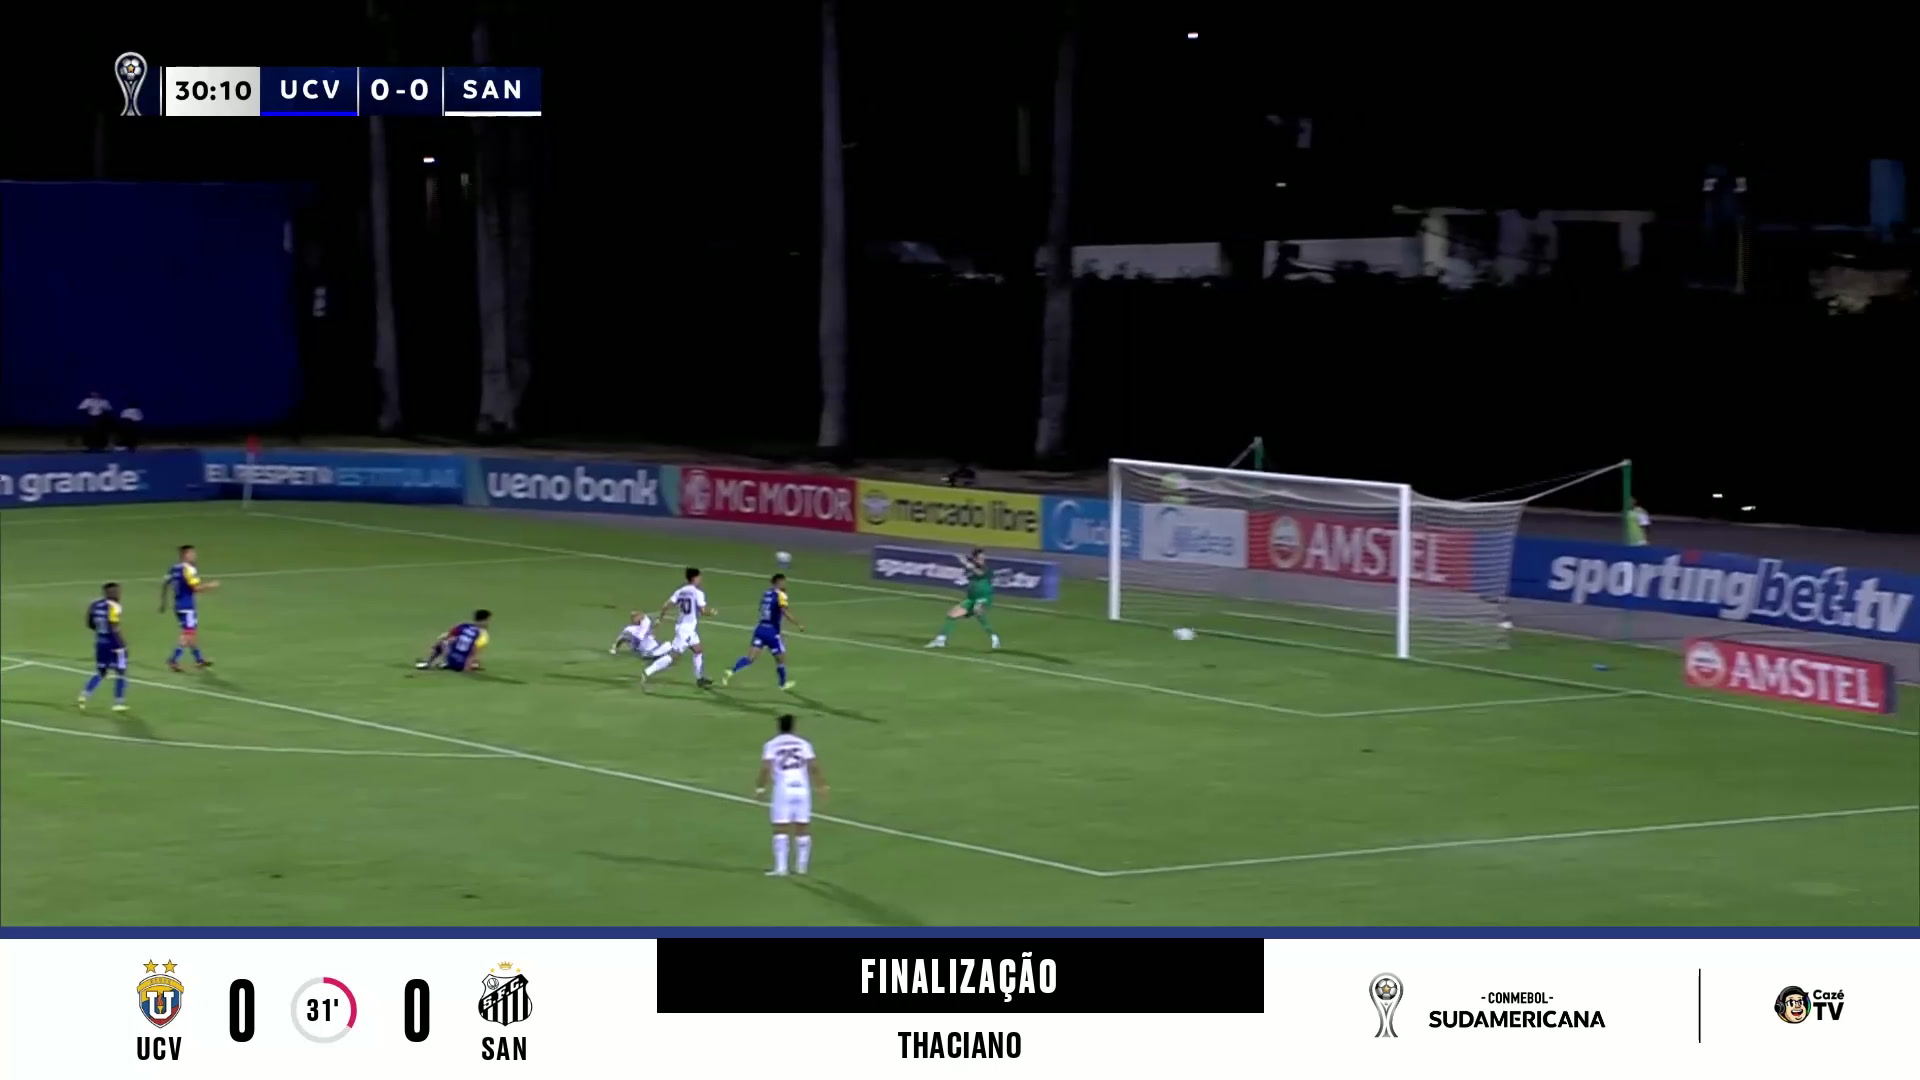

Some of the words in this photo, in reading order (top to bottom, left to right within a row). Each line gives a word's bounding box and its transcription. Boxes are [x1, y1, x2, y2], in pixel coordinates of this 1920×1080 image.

[19, 463, 140, 502] grande
[487, 469, 572, 501] ueno
[574, 466, 658, 507] bank
[713, 477, 757, 513] MG
[758, 481, 854, 522] MOTOR
[894, 497, 985, 529] mercado
[987, 500, 1037, 534] libre
[1548, 555, 1914, 633] sportingbet.tv
[1727, 650, 1880, 709] AMSTEL
[775, 747, 804, 771] 25
